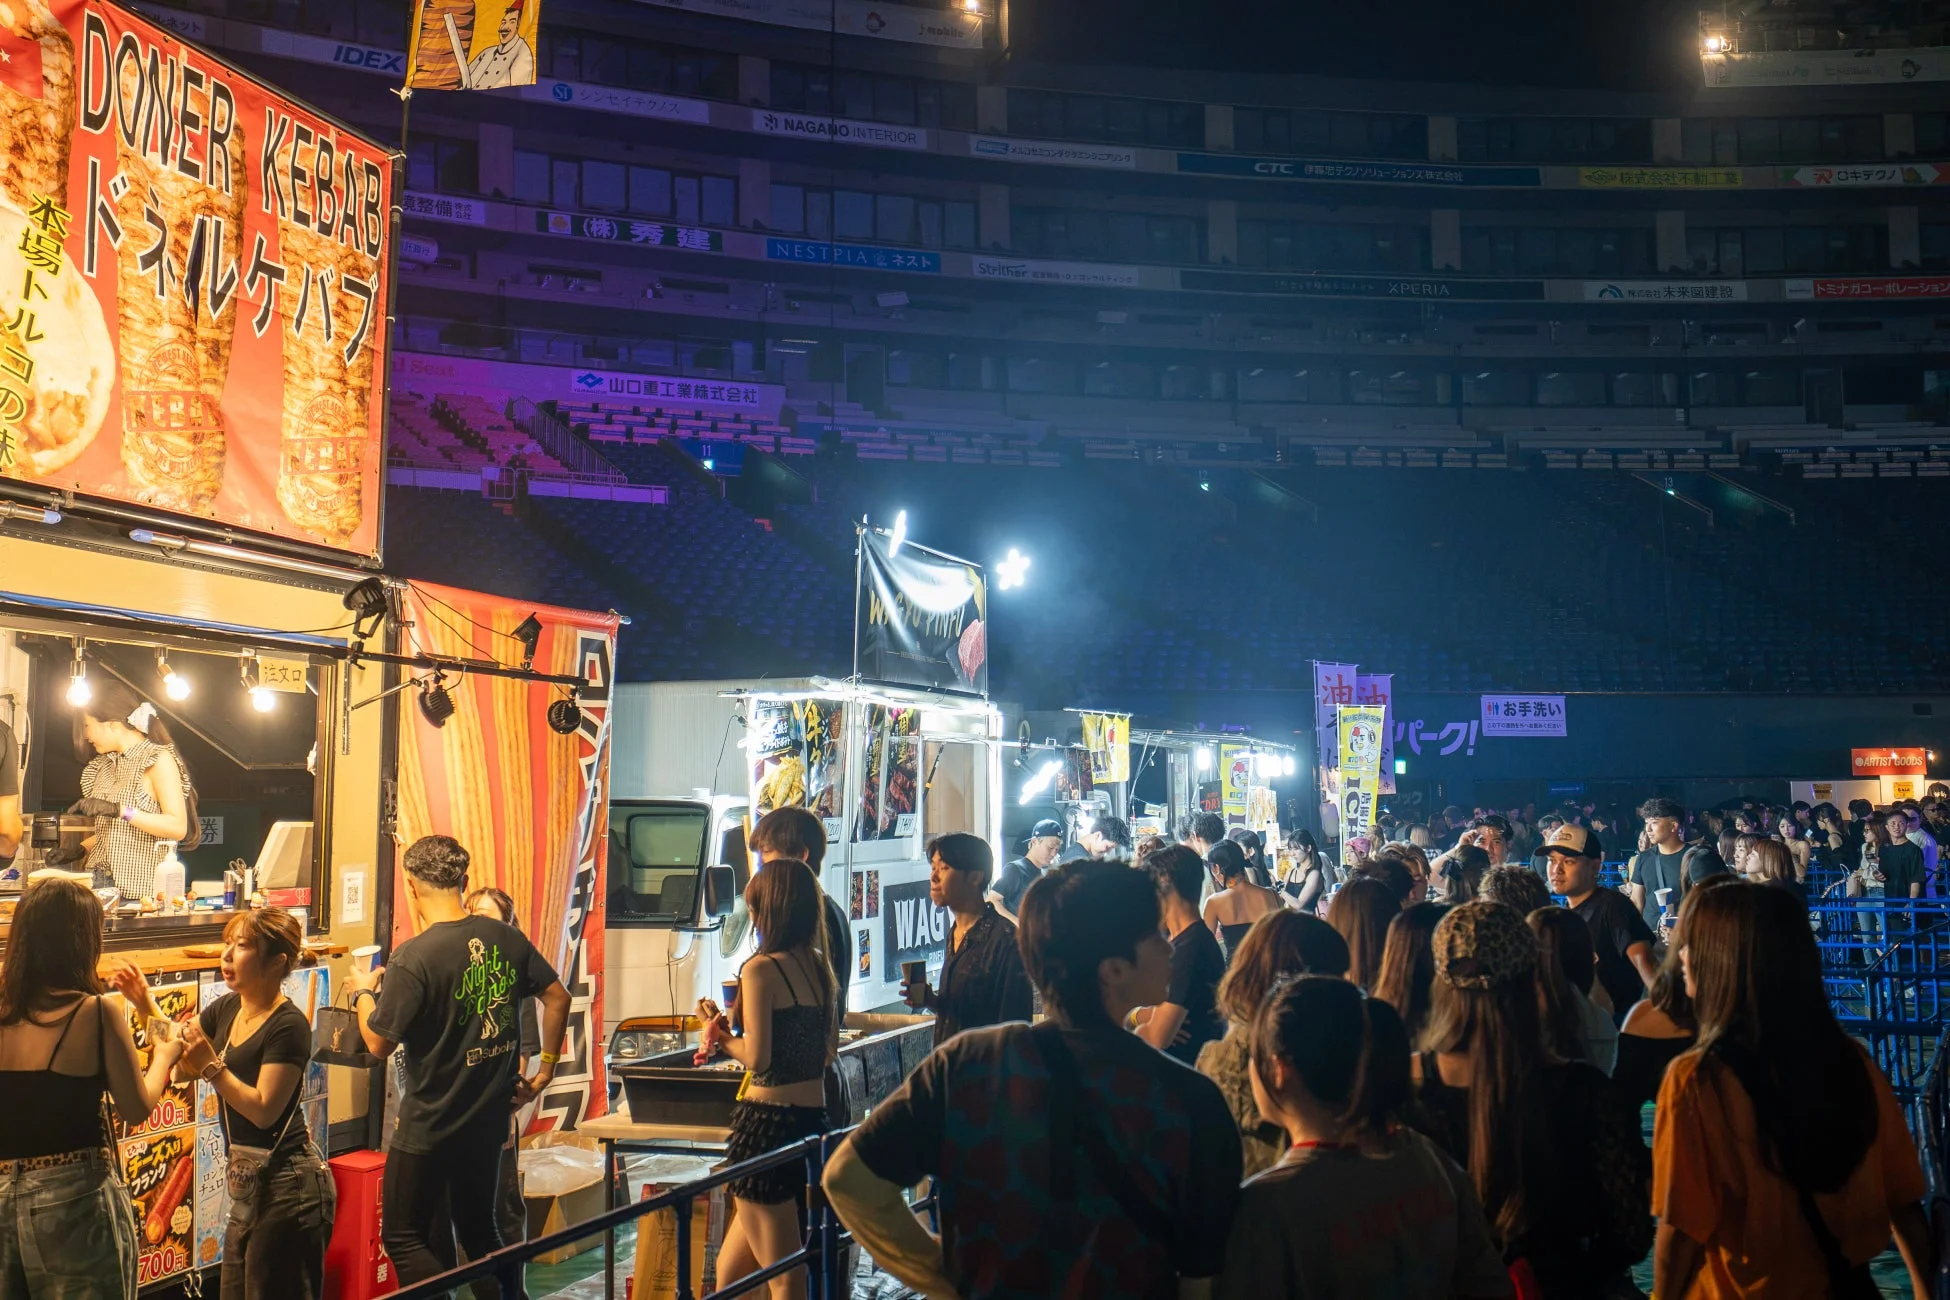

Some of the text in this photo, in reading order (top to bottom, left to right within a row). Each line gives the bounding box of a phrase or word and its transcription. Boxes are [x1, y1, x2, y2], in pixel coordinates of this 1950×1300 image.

[333, 45, 404, 73] IDEX
[80, 8, 383, 261] DONER KEBAB
[784, 118, 917, 144] NAGANO INTERIOR
[1837, 169, 1896, 182] ロキテクノ
[83, 155, 381, 369] ドネルケバブ
[776, 242, 867, 264] NESTPIA
[892, 253, 931, 268] ネスト
[1388, 281, 1450, 297] XPERIA
[609, 377, 758, 404] 山口重工業株式会社
[701, 444, 711, 457] 11
[263, 663, 302, 684] 注文口
[1503, 701, 1562, 717] お手洗い
[1863, 756, 1923, 767] ARTIST GOODS
[893, 896, 955, 951] WAG
[454, 944, 502, 1000] Night
[128, 1138, 182, 1179] チーズ入り
[377, 1219, 388, 1284] 火器
[138, 1246, 184, 1284] 700円
